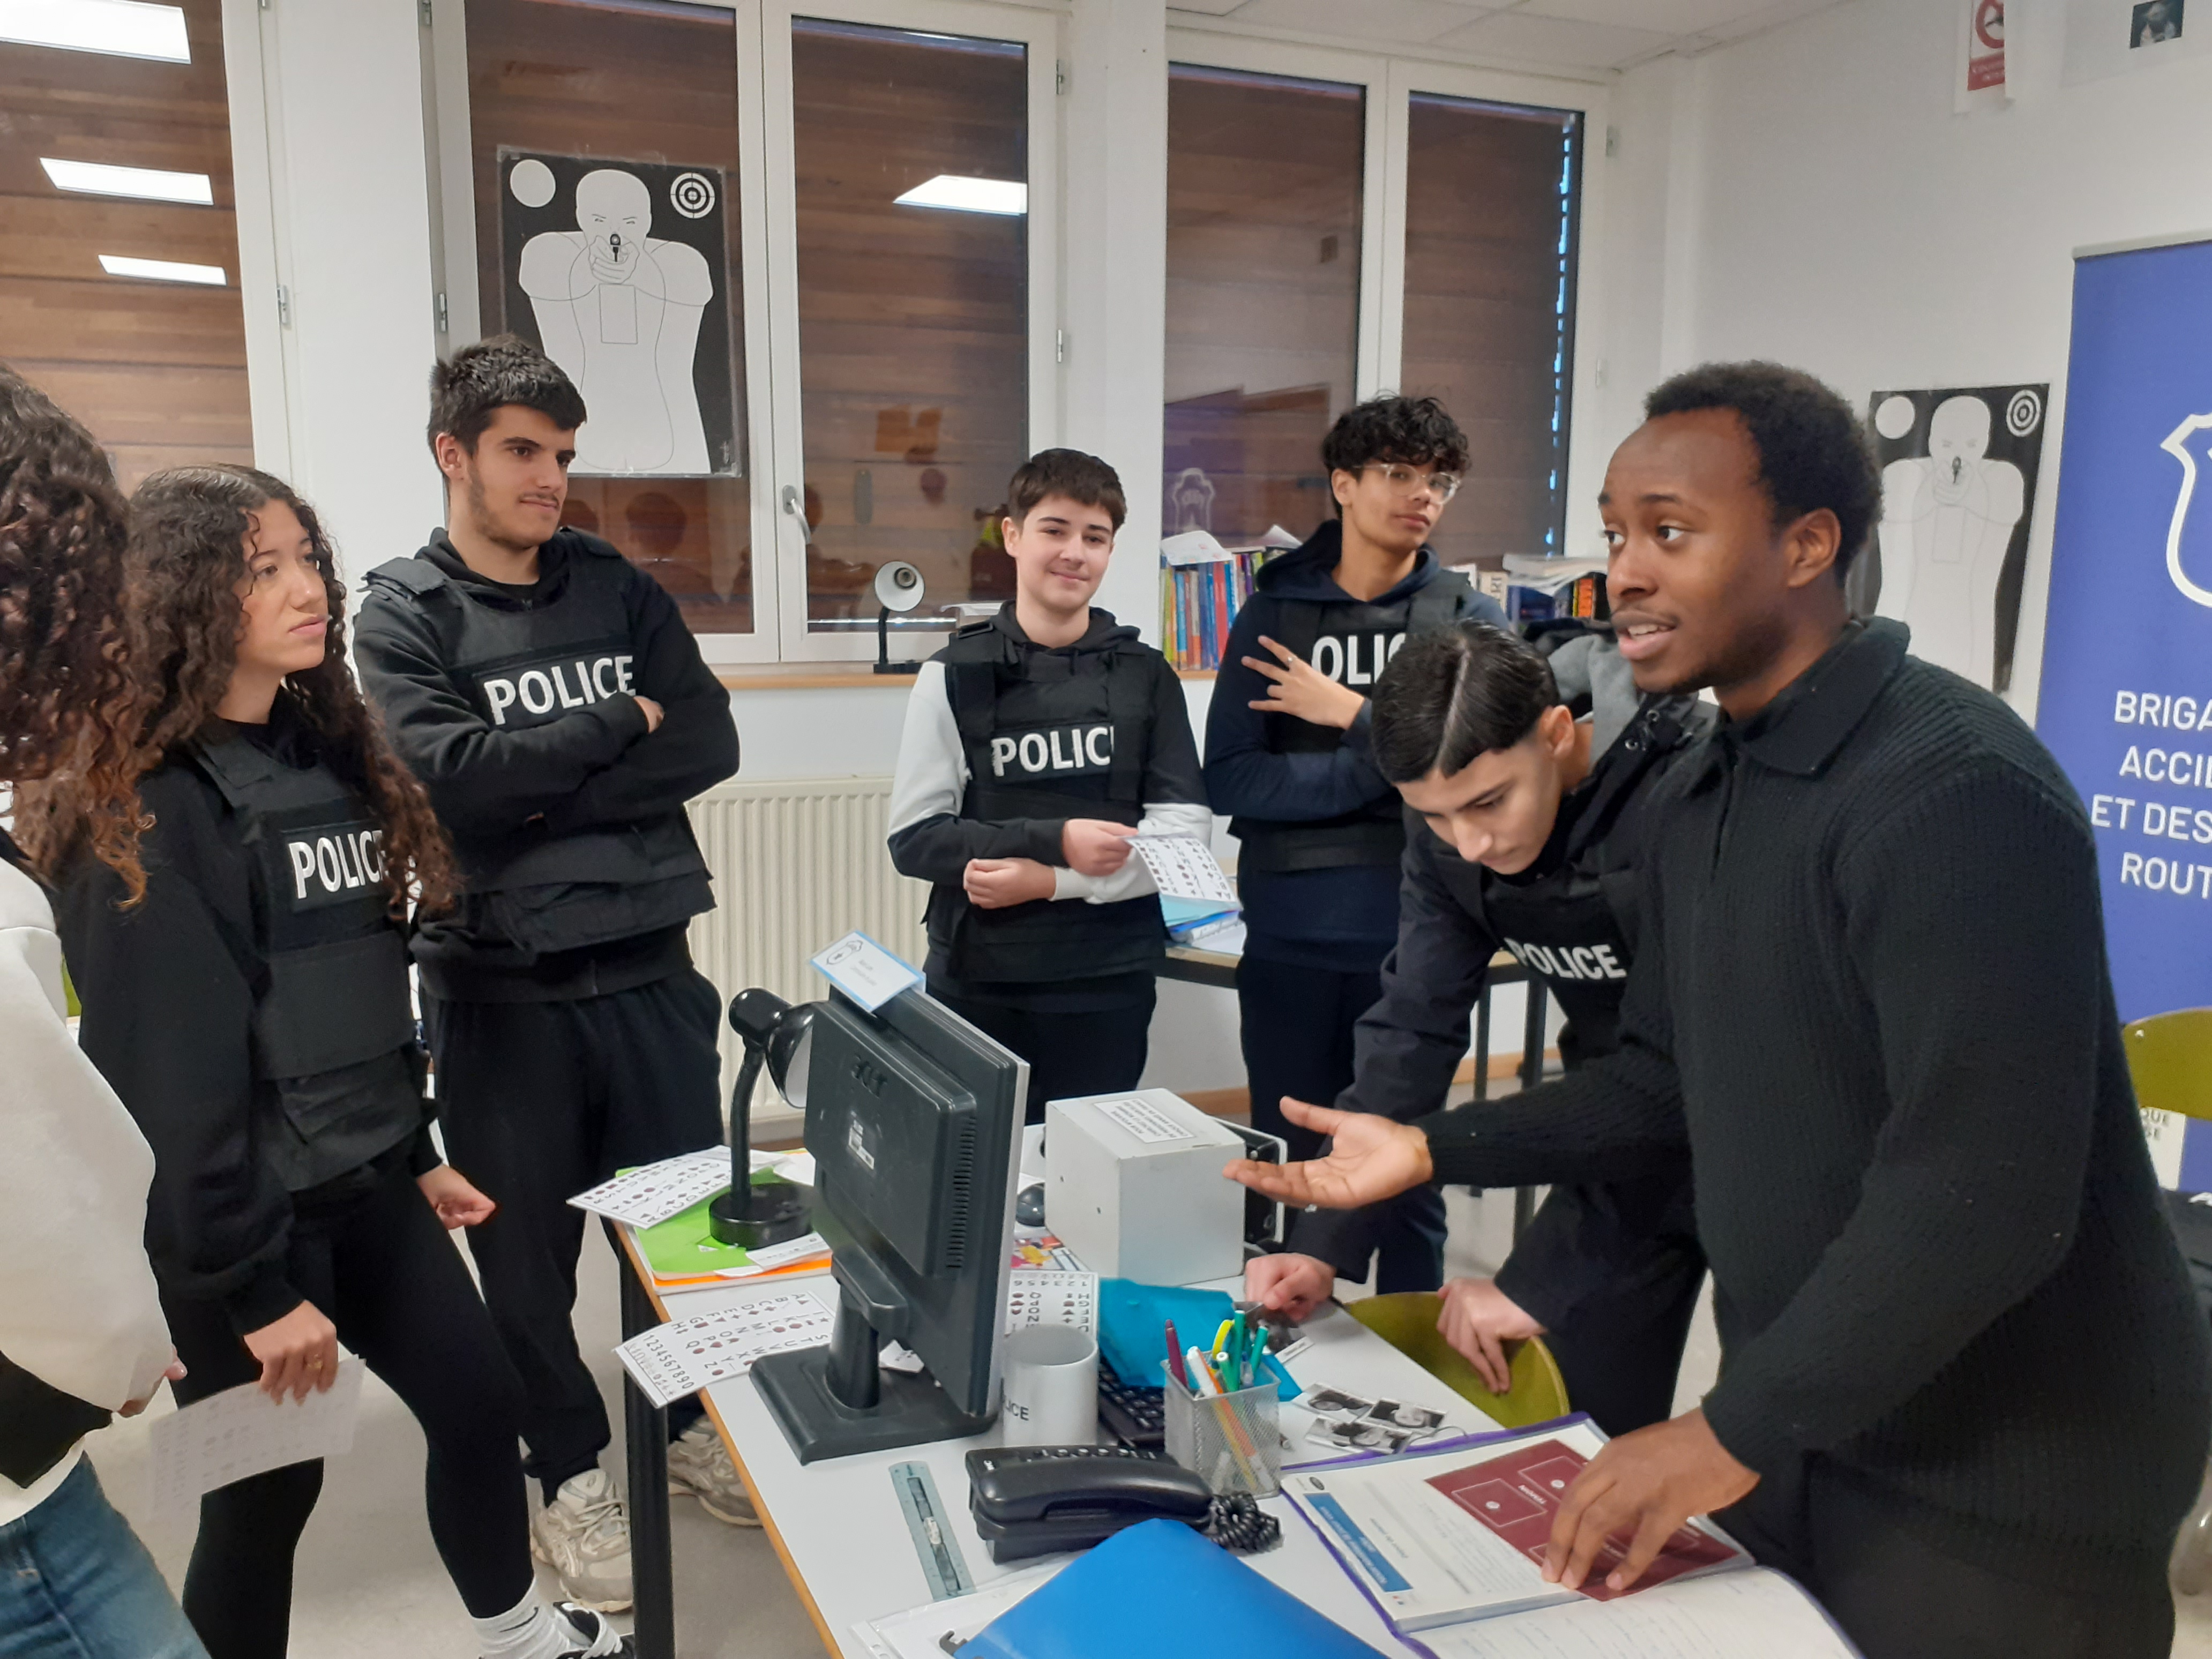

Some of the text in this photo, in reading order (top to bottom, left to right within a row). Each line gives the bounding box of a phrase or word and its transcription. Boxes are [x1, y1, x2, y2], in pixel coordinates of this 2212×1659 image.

[483, 655, 636, 725] POLICE
[990, 726, 1114, 776] POLIC
[2091, 794, 2212, 844] ET DES
[1504, 937, 1627, 979] POLICE
